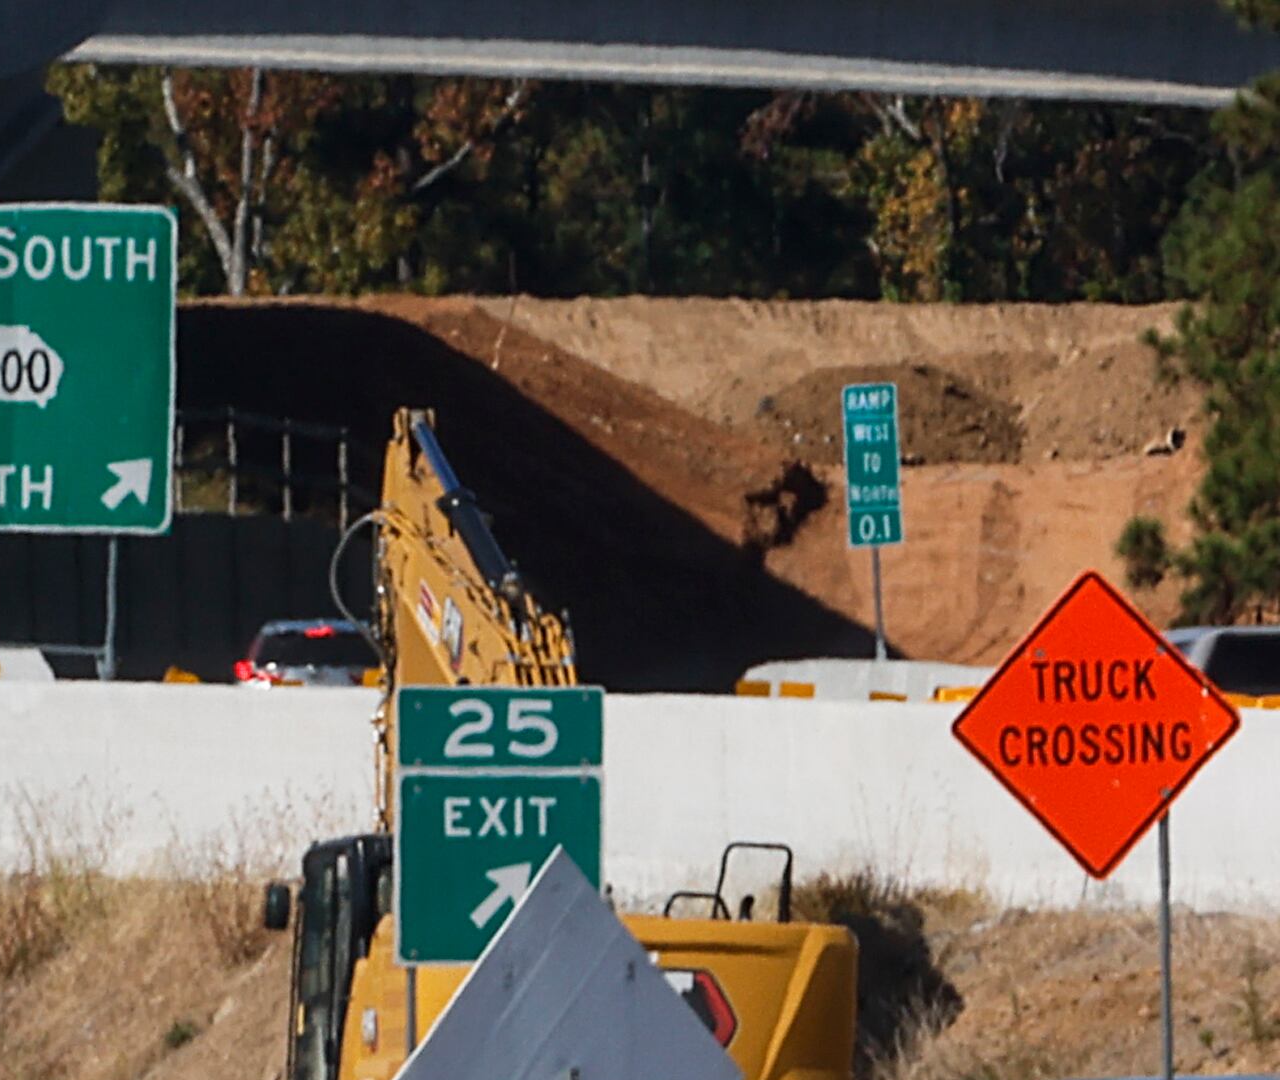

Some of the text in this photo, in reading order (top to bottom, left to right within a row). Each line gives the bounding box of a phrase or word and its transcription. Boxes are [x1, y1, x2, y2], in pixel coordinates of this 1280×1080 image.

[847, 389, 890, 411] RAMP
[863, 452, 882, 474] TO
[858, 514, 892, 541] 0.1
[1030, 658, 1158, 703] TRUCK
[443, 697, 559, 759] 25
[998, 720, 1193, 767] CROSSING
[443, 796, 558, 837] EXIT
